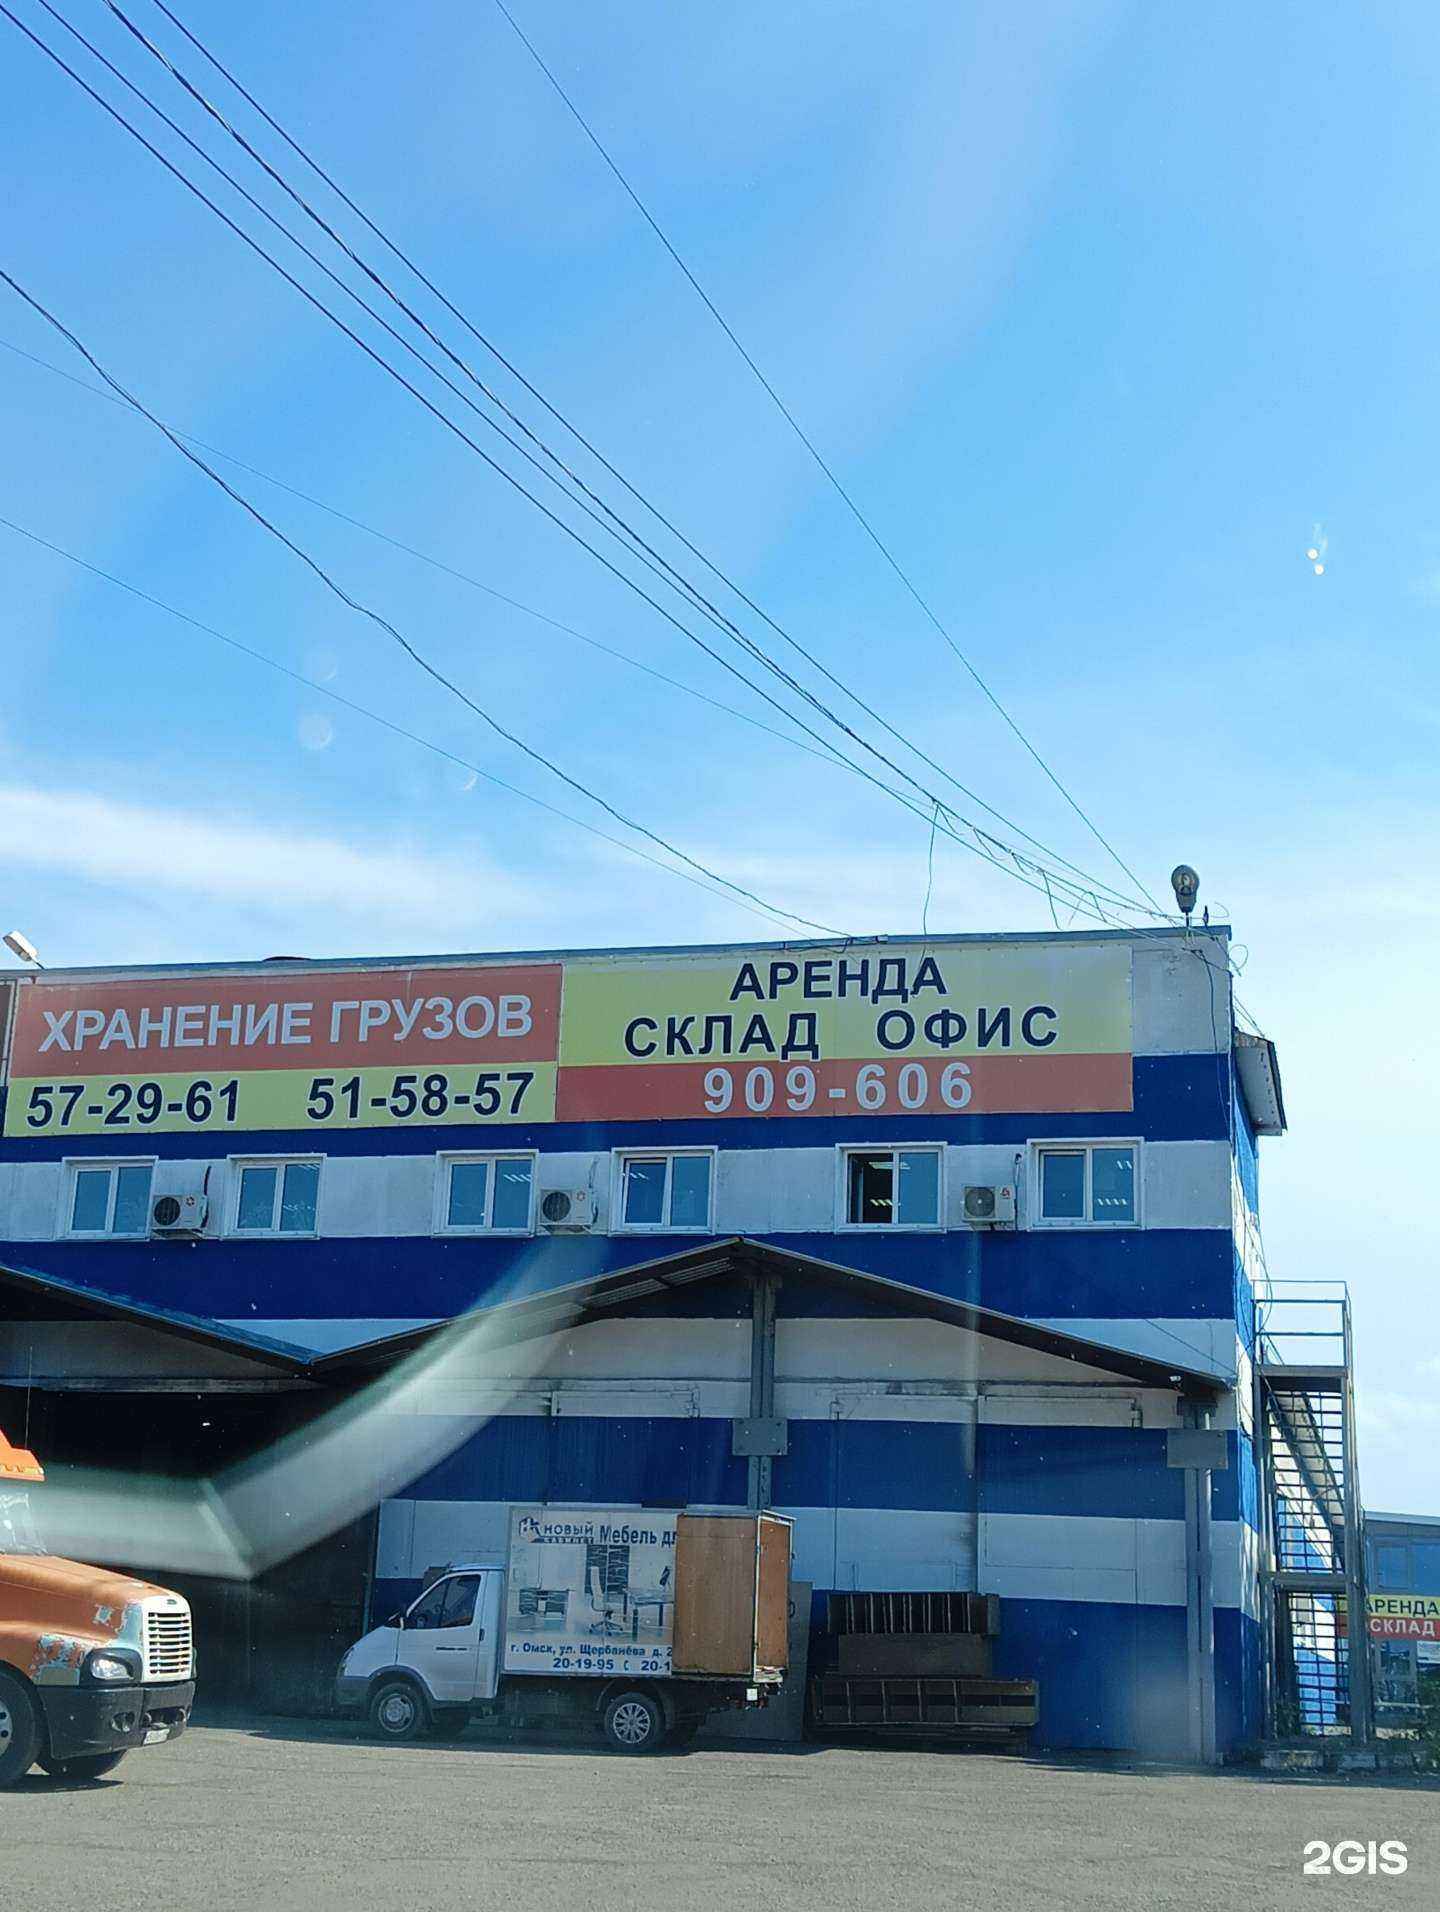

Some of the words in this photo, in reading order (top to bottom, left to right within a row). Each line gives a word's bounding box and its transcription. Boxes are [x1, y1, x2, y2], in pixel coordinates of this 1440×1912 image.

[729, 956, 947, 1003] АРЕНДА
[38, 1003, 313, 1052] ХРАНЕНИЕ
[329, 995, 534, 1043] ГРУЗОВ
[623, 1012, 820, 1062] СКЛАД
[876, 1006, 1058, 1050] ОФИС
[26, 1079, 240, 1129] 57-29-61
[306, 1071, 536, 1120] 51-58-57
[703, 1062, 973, 1114] 909-606
[600, 1525, 658, 1545] Мебель
[511, 1644, 519, 1652] г.
[1370, 1618, 1436, 1637] СКЛАД
[553, 1657, 614, 1670] 20-19-95
